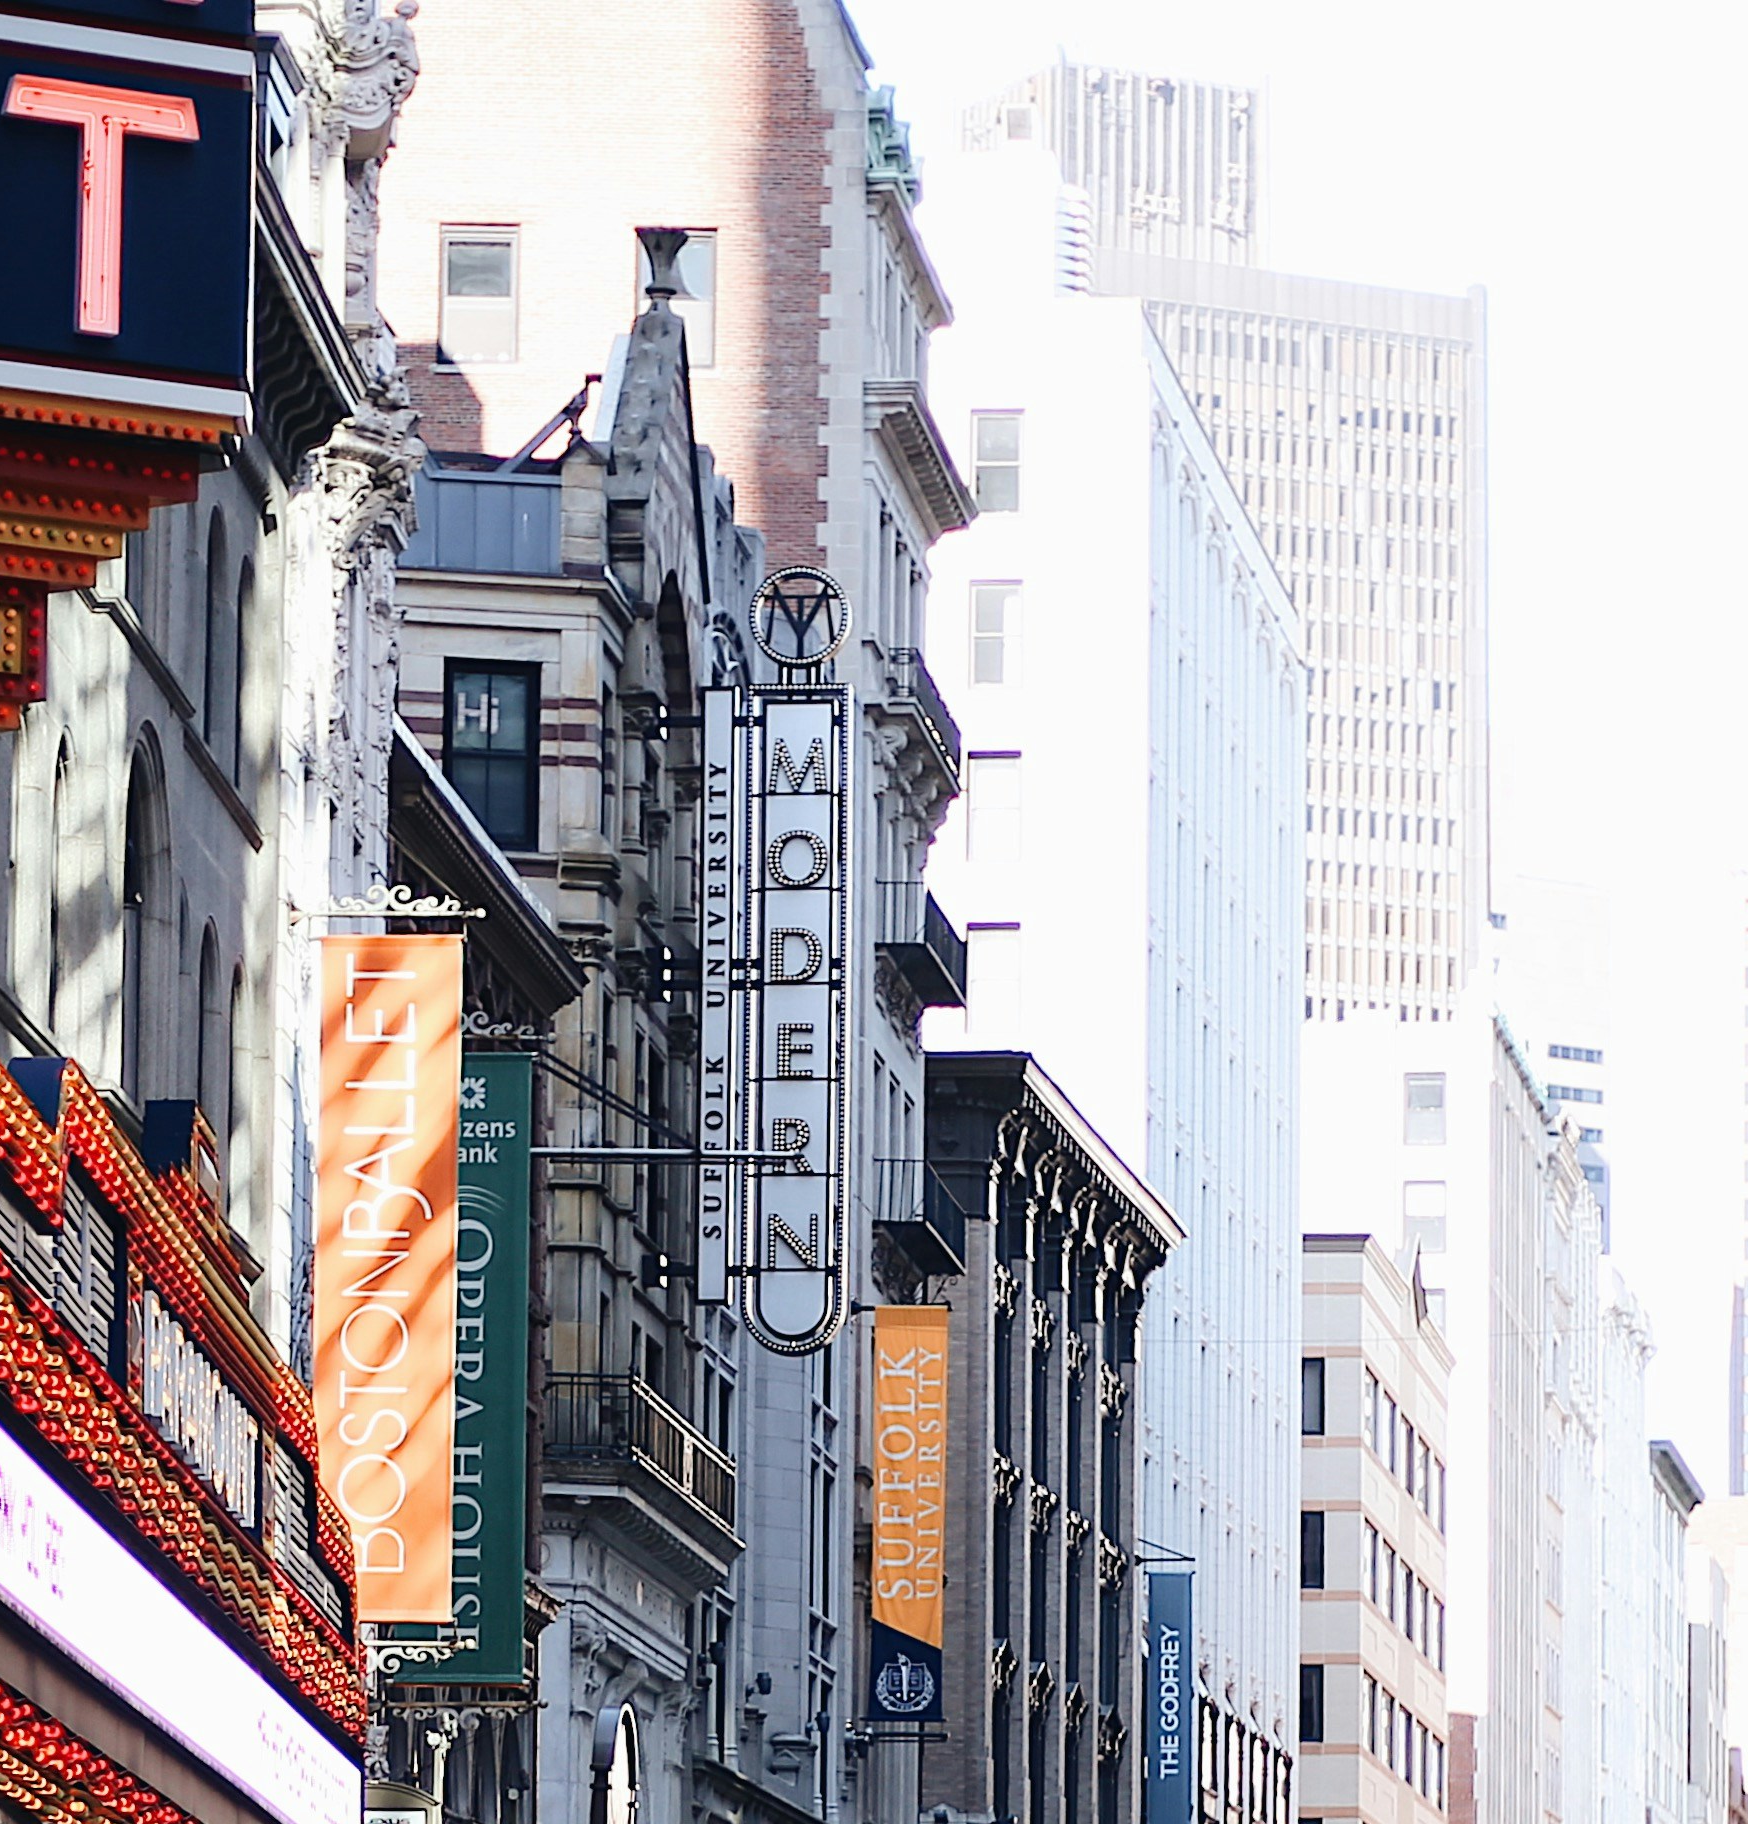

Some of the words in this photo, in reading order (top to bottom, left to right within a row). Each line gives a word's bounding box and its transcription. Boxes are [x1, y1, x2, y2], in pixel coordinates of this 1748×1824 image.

[457, 692, 499, 735] Hi
[705, 761, 729, 1010] UNIVERSITY
[766, 737, 829, 1269] MODERN
[458, 1119, 516, 1139] zens
[458, 1141, 498, 1163] ank
[703, 1055, 726, 1240] SUFFOLK
[453, 1217, 495, 1422] OPERA
[438, 1440, 485, 1650] HOUSE
[877, 1346, 917, 1602] SUFFOLK
[916, 1346, 944, 1602] UNIVERSITY
[1159, 1624, 1181, 1732] GODFREY
[1159, 1734, 1181, 1781] THE
